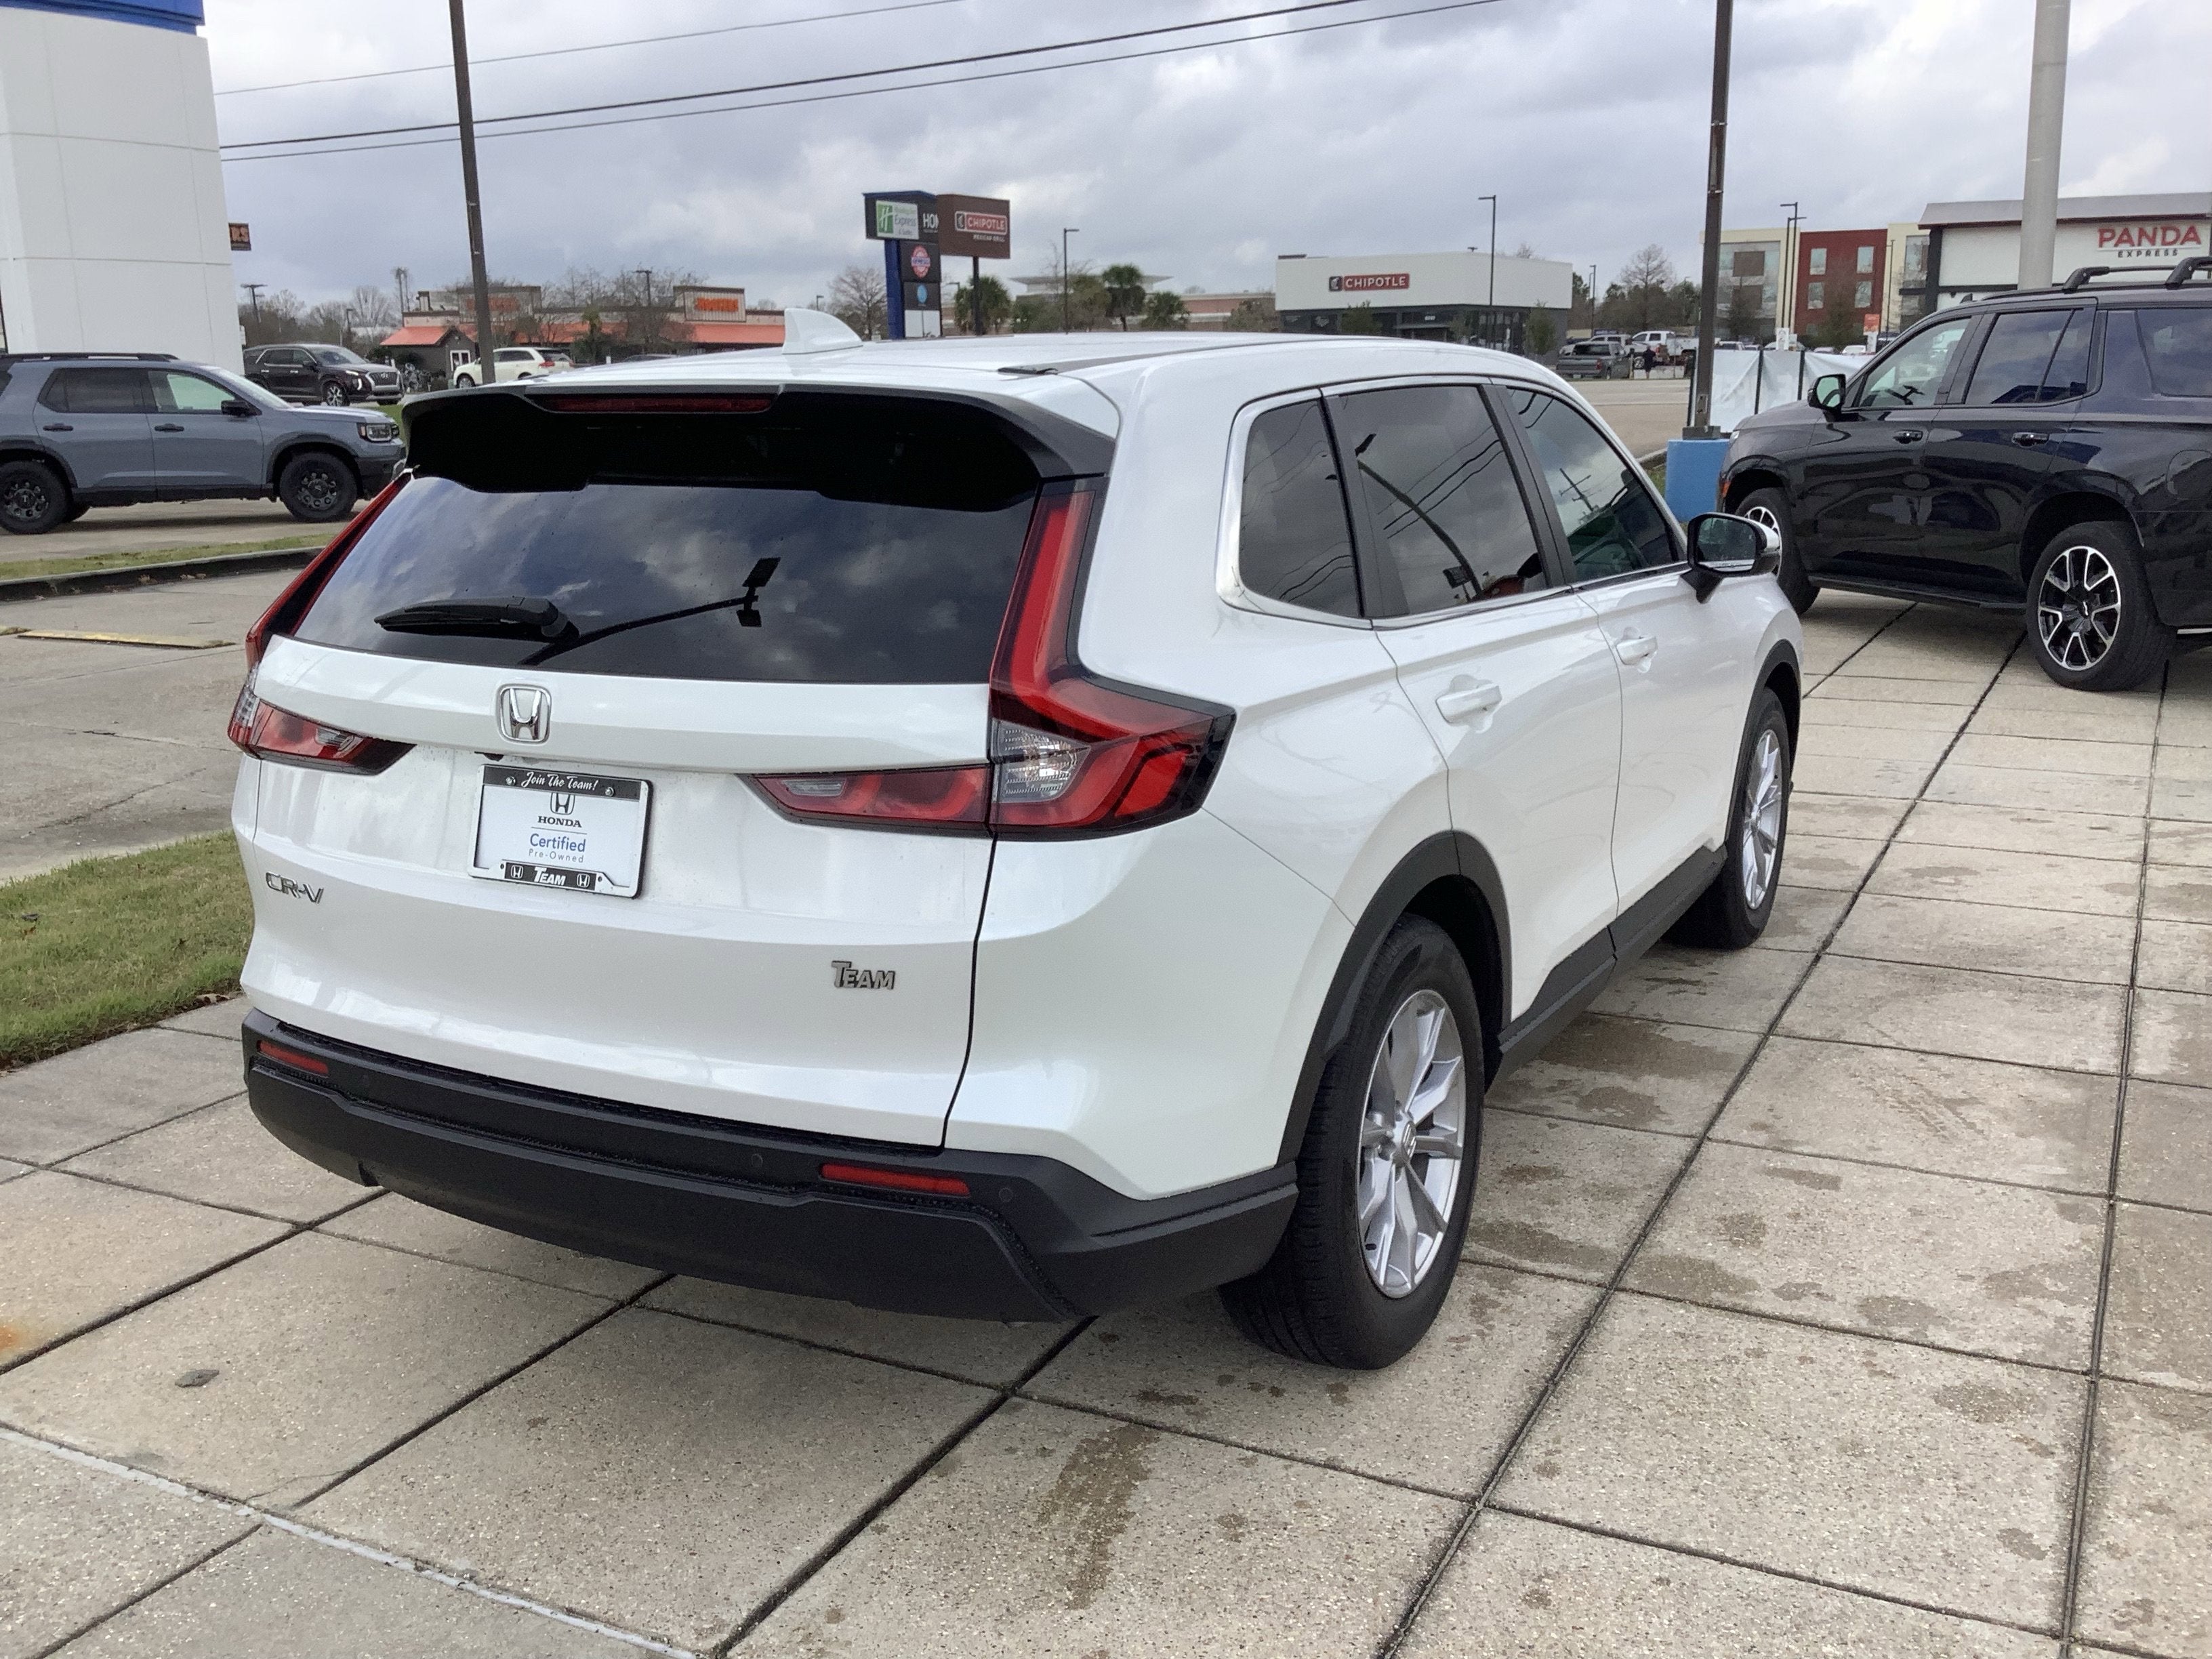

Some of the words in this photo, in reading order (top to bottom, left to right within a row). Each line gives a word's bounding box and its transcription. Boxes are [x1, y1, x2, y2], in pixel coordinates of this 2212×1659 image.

[967, 217, 1004, 230] CHIPOTLE
[2097, 225, 2202, 248] PANDA
[2118, 249, 2179, 258] EXPRESS
[1345, 276, 1406, 288] CHIPOTLE
[520, 771, 546, 787] Join
[547, 774, 565, 787] The
[567, 776, 598, 791] Team!
[537, 815, 583, 827] HONDA
[530, 833, 586, 852] Certified
[529, 848, 584, 863] Pre-Owned
[534, 866, 566, 886] TEAM
[266, 872, 324, 904] CR-V
[832, 960, 895, 989] TEAM
